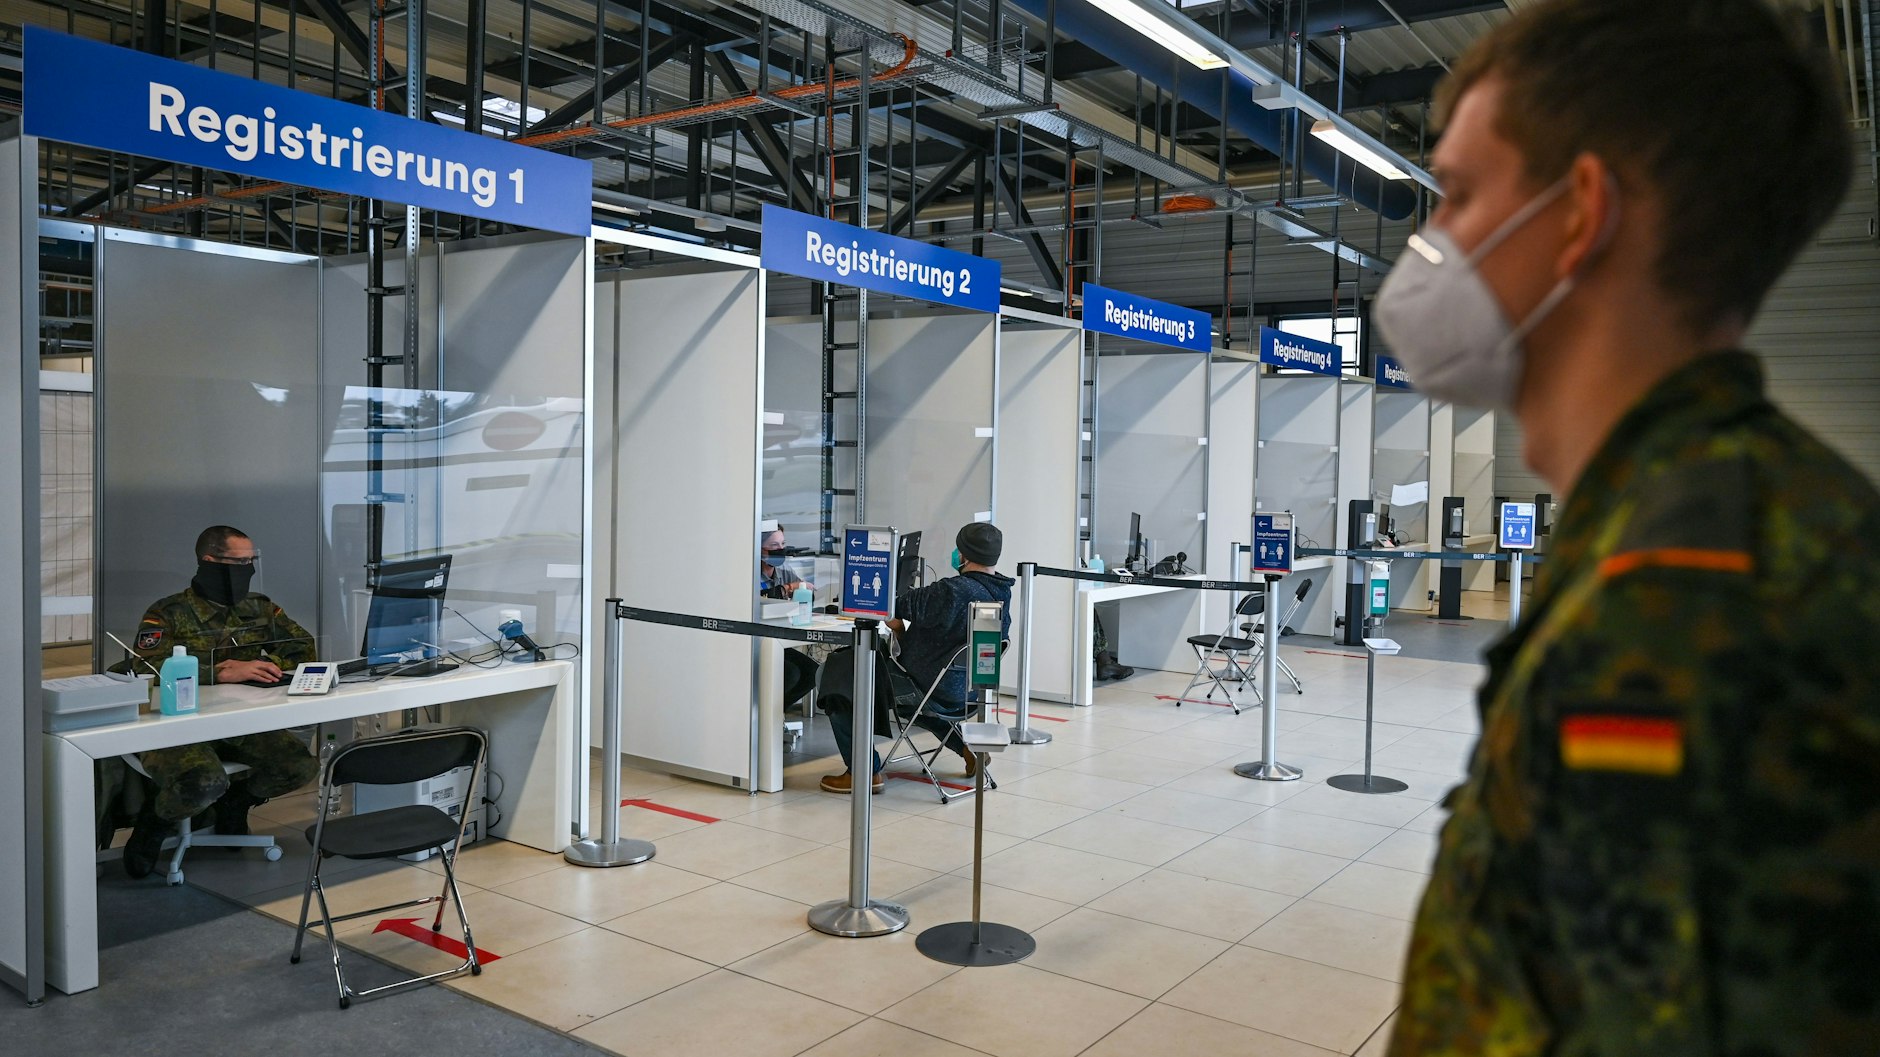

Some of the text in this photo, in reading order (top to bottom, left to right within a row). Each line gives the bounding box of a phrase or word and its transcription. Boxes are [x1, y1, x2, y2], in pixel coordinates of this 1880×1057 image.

[148, 81, 524, 208] Registrierung 1
[806, 230, 971, 298] Registrierung 2
[1105, 299, 1195, 343] Registrierung 3
[1273, 338, 1332, 370] Registrierung 4
[1384, 363, 1414, 384] Registrier
[848, 554, 887, 563] Impfzentrum
[702, 618, 718, 630] BER
[806, 631, 824, 641] BER
